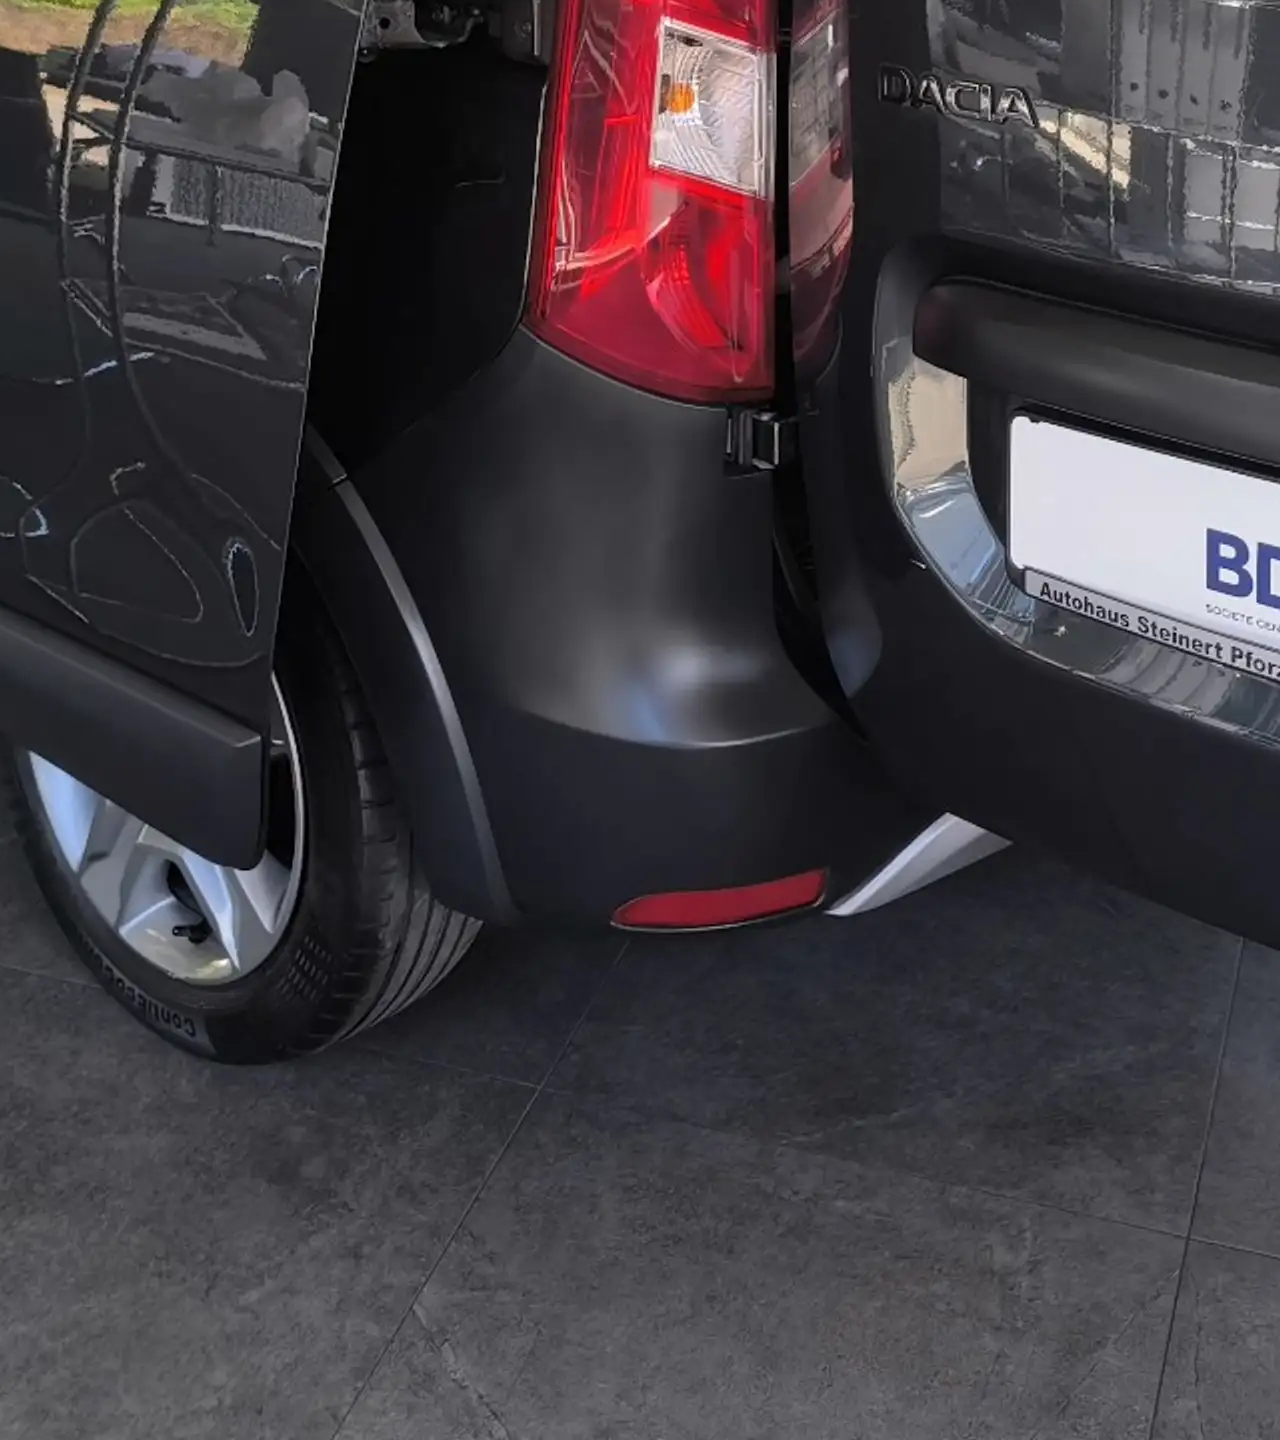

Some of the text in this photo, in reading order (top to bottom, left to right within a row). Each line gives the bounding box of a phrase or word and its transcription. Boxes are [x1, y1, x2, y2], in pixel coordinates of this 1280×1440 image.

[878, 62, 1040, 129] DACIA
[1039, 581, 1130, 628] Autohaus
[1137, 615, 1224, 659] Steinert
